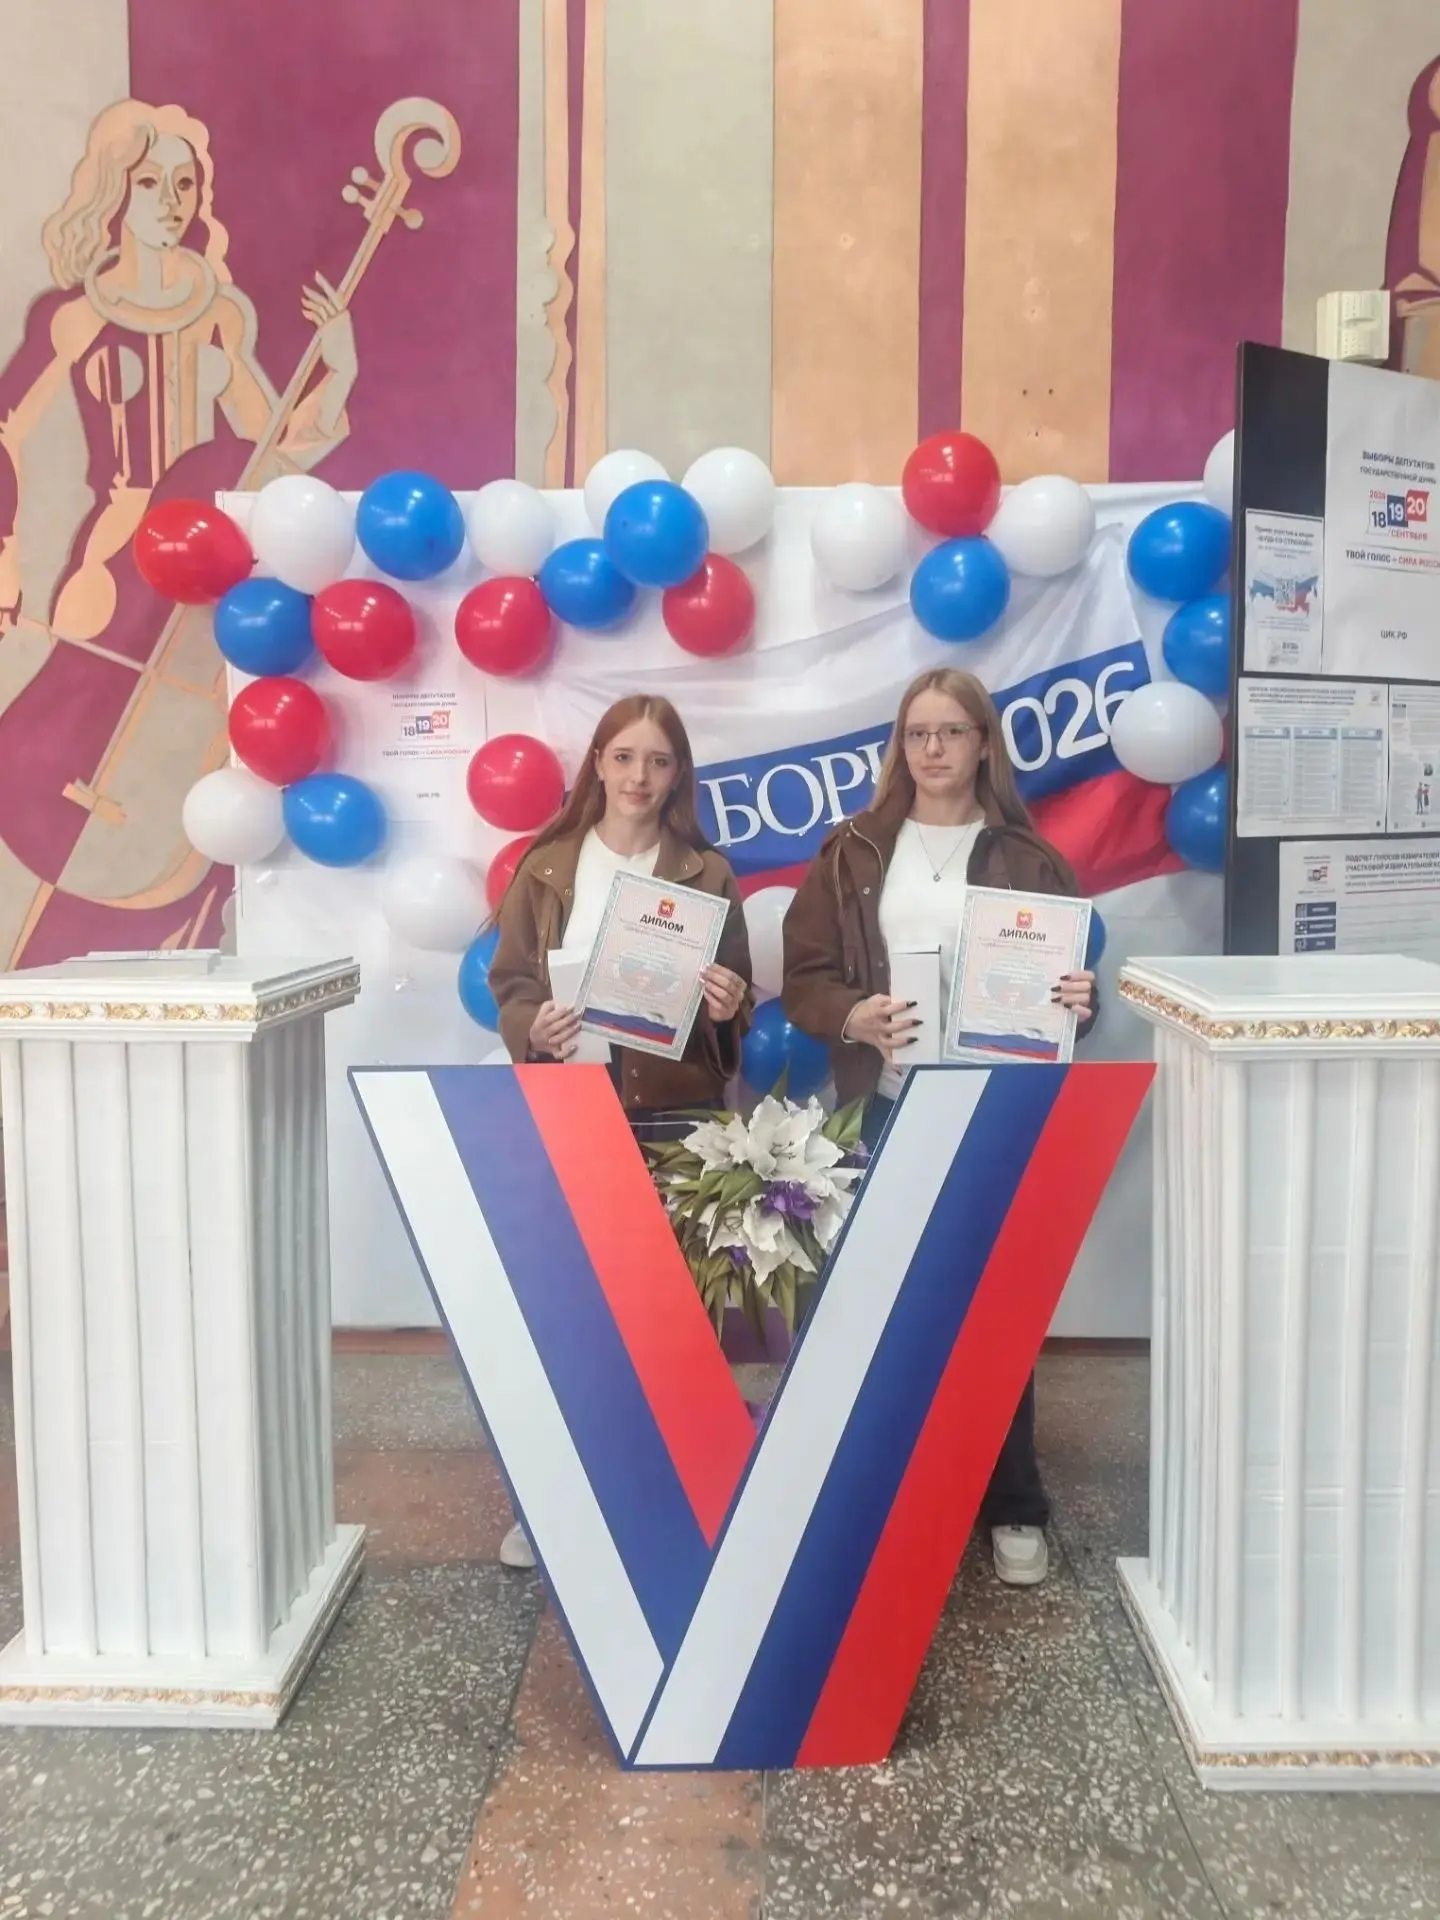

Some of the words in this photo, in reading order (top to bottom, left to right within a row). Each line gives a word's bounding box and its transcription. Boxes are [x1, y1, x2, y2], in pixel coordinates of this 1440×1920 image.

[1371, 511, 1387, 528] 18
[1388, 503, 1404, 522] 19
[1407, 496, 1425, 516] 20
[1345, 549, 1366, 560] ТВОЙ
[1366, 552, 1391, 563] ГОЛОС
[403, 726, 416, 737] 18
[417, 719, 430, 731] 19
[432, 714, 448, 726] 20
[1001, 661, 1135, 772] 026
[640, 913, 684, 933] ДИПЛОМ
[999, 927, 1047, 942] ДИПЛОМ
